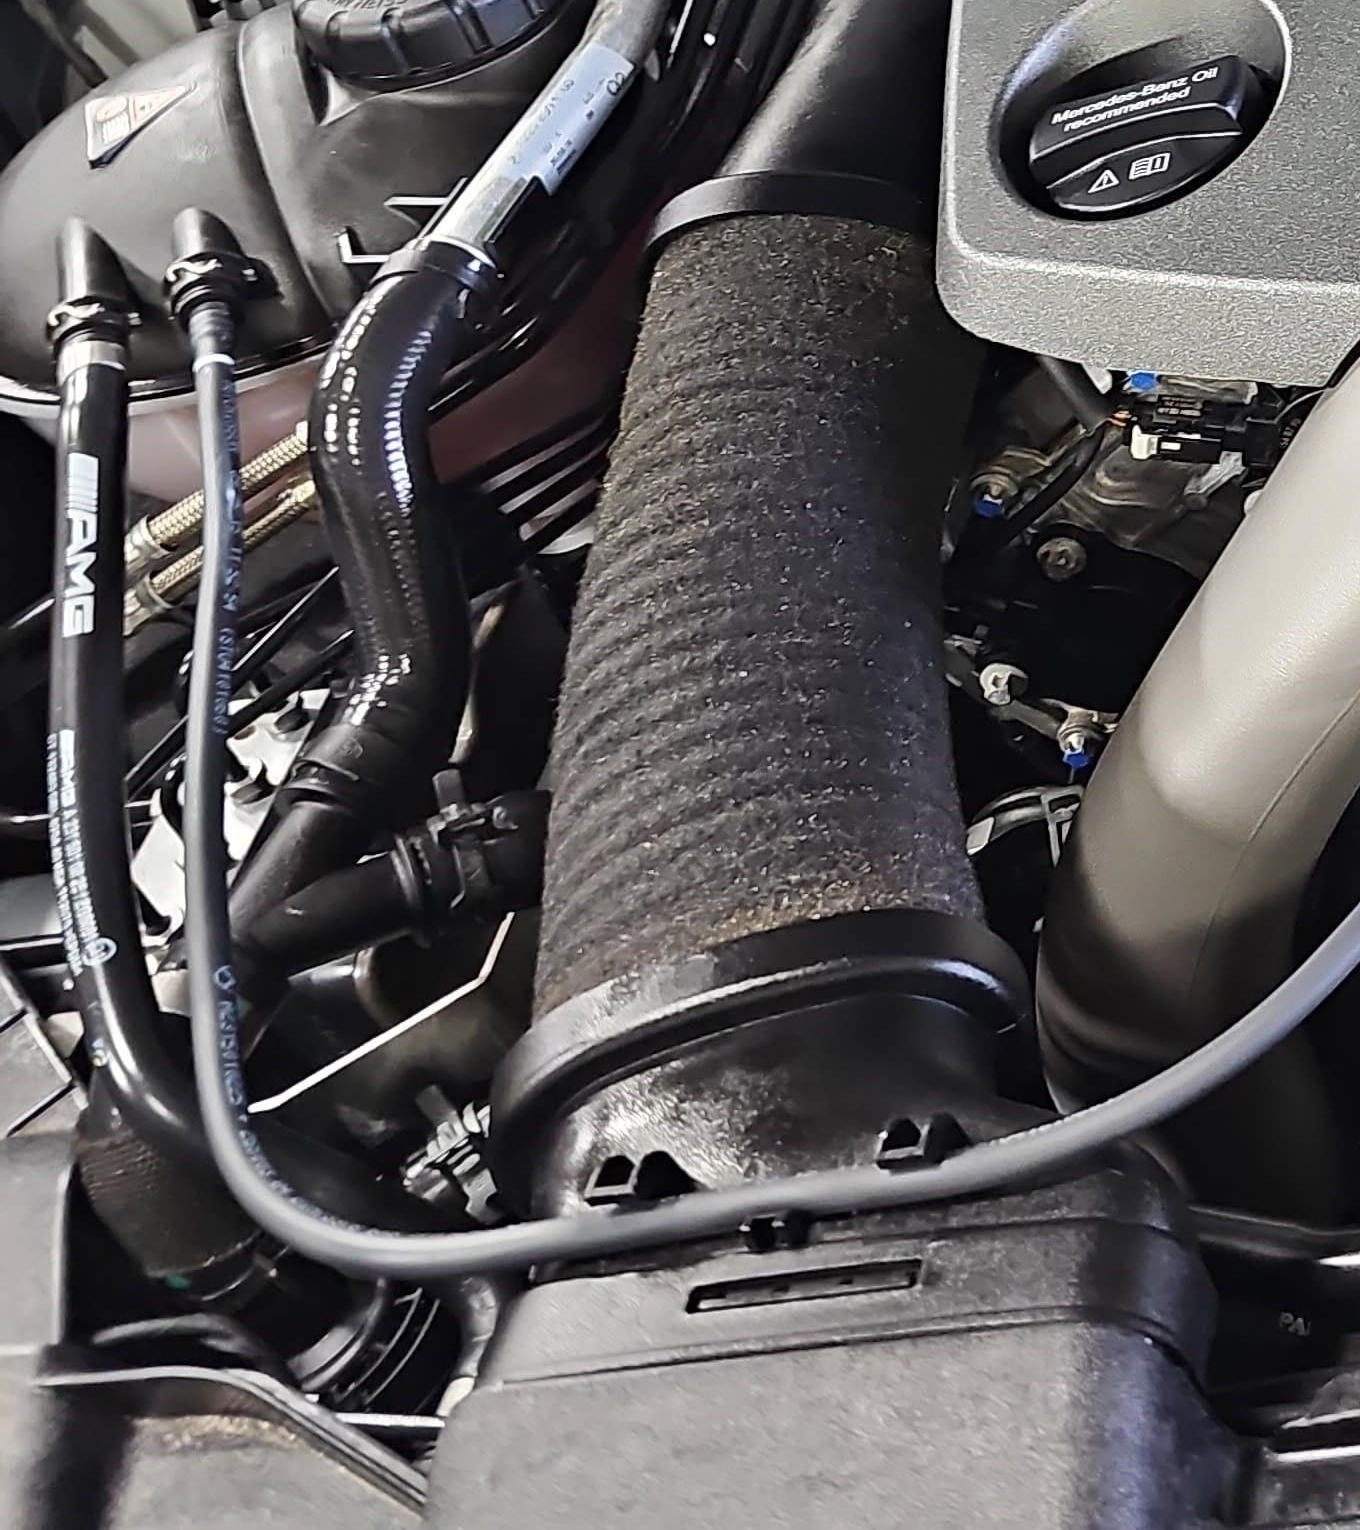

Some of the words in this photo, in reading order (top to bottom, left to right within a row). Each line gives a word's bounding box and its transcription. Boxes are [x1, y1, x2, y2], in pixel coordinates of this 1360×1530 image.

[1051, 76, 1188, 124] Mercedes-Benz
[1191, 67, 1219, 83] Oil
[1063, 86, 1191, 132] recommended
[63, 495, 98, 638] AMG
